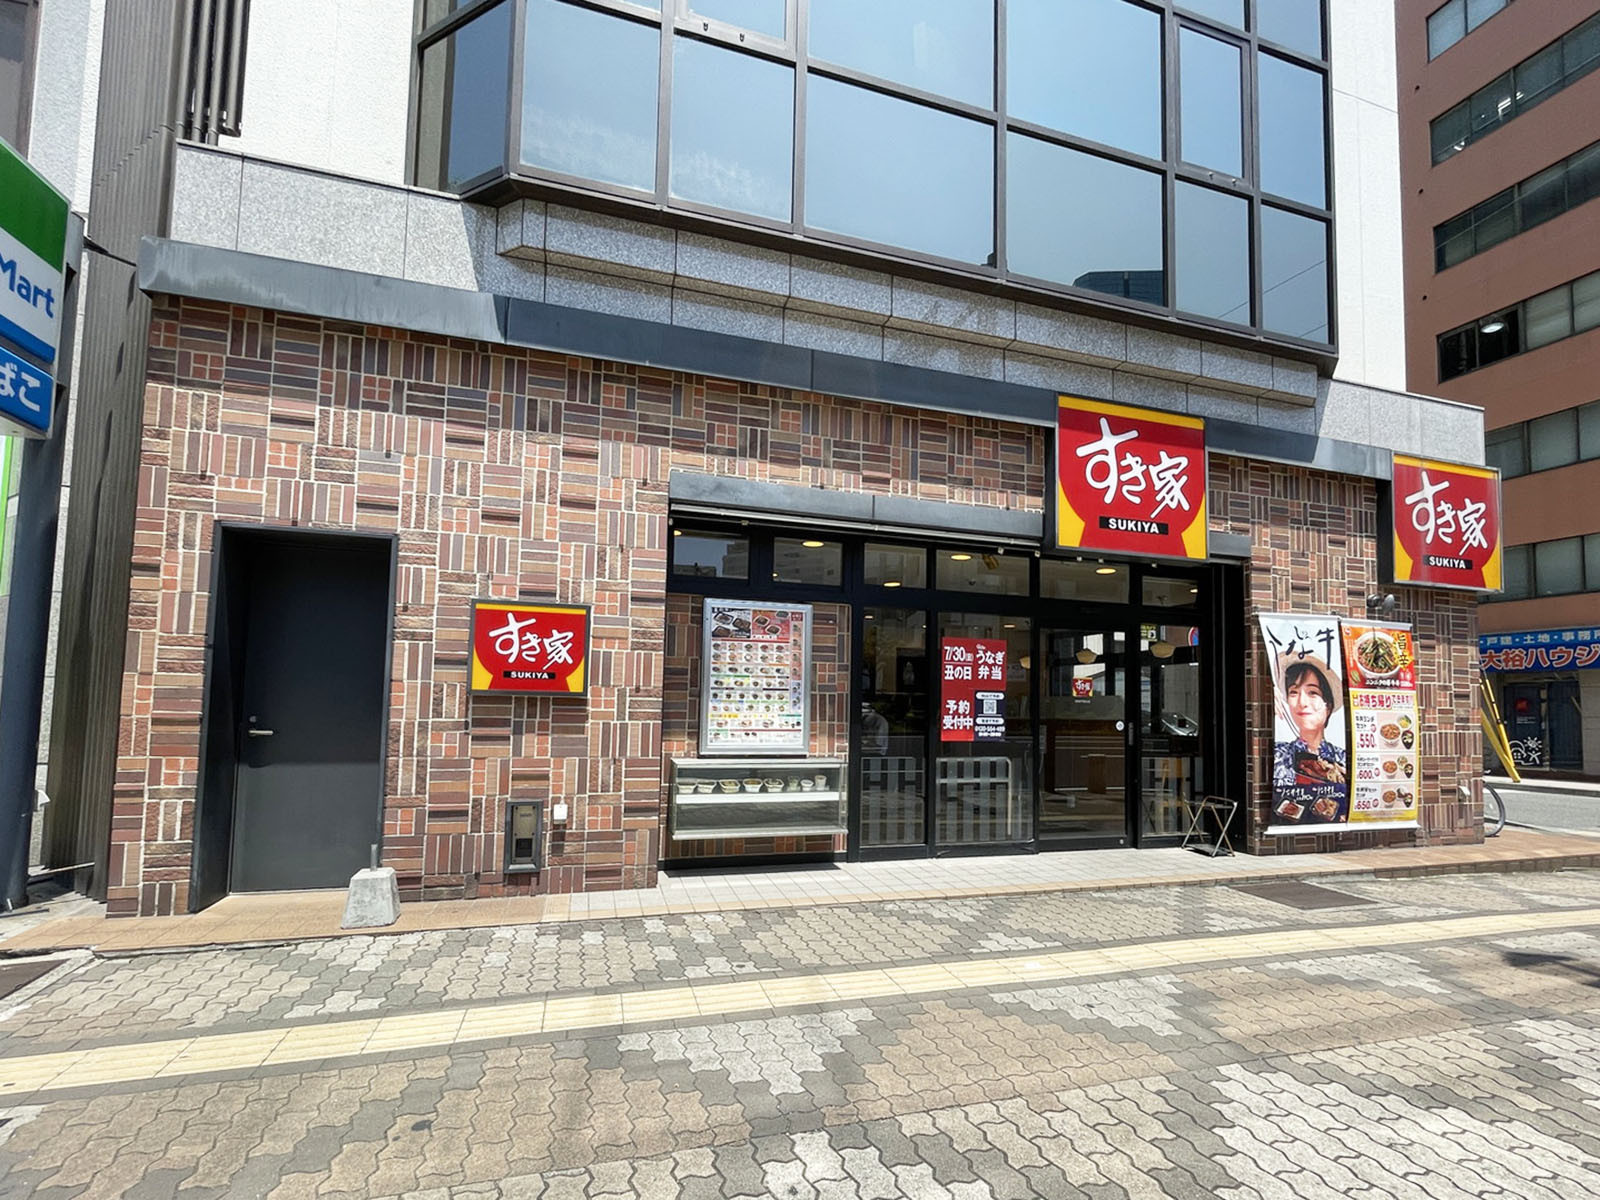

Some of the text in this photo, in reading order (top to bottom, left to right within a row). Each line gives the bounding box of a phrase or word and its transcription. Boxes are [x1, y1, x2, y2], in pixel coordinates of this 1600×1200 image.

[1075, 417, 1191, 519] すき家
[1405, 470, 1488, 556] すき家
[1108, 518, 1159, 534] SUKIYA
[1429, 556, 1466, 569] SUKIYA
[488, 612, 574, 671] すき家
[976, 650, 1005, 664] うなぎ
[510, 671, 549, 679] SUKIYA
[944, 665, 972, 680] 丑の日
[978, 666, 1002, 680] 弁当
[945, 700, 970, 714] 予約
[943, 715, 973, 730] 受付中
